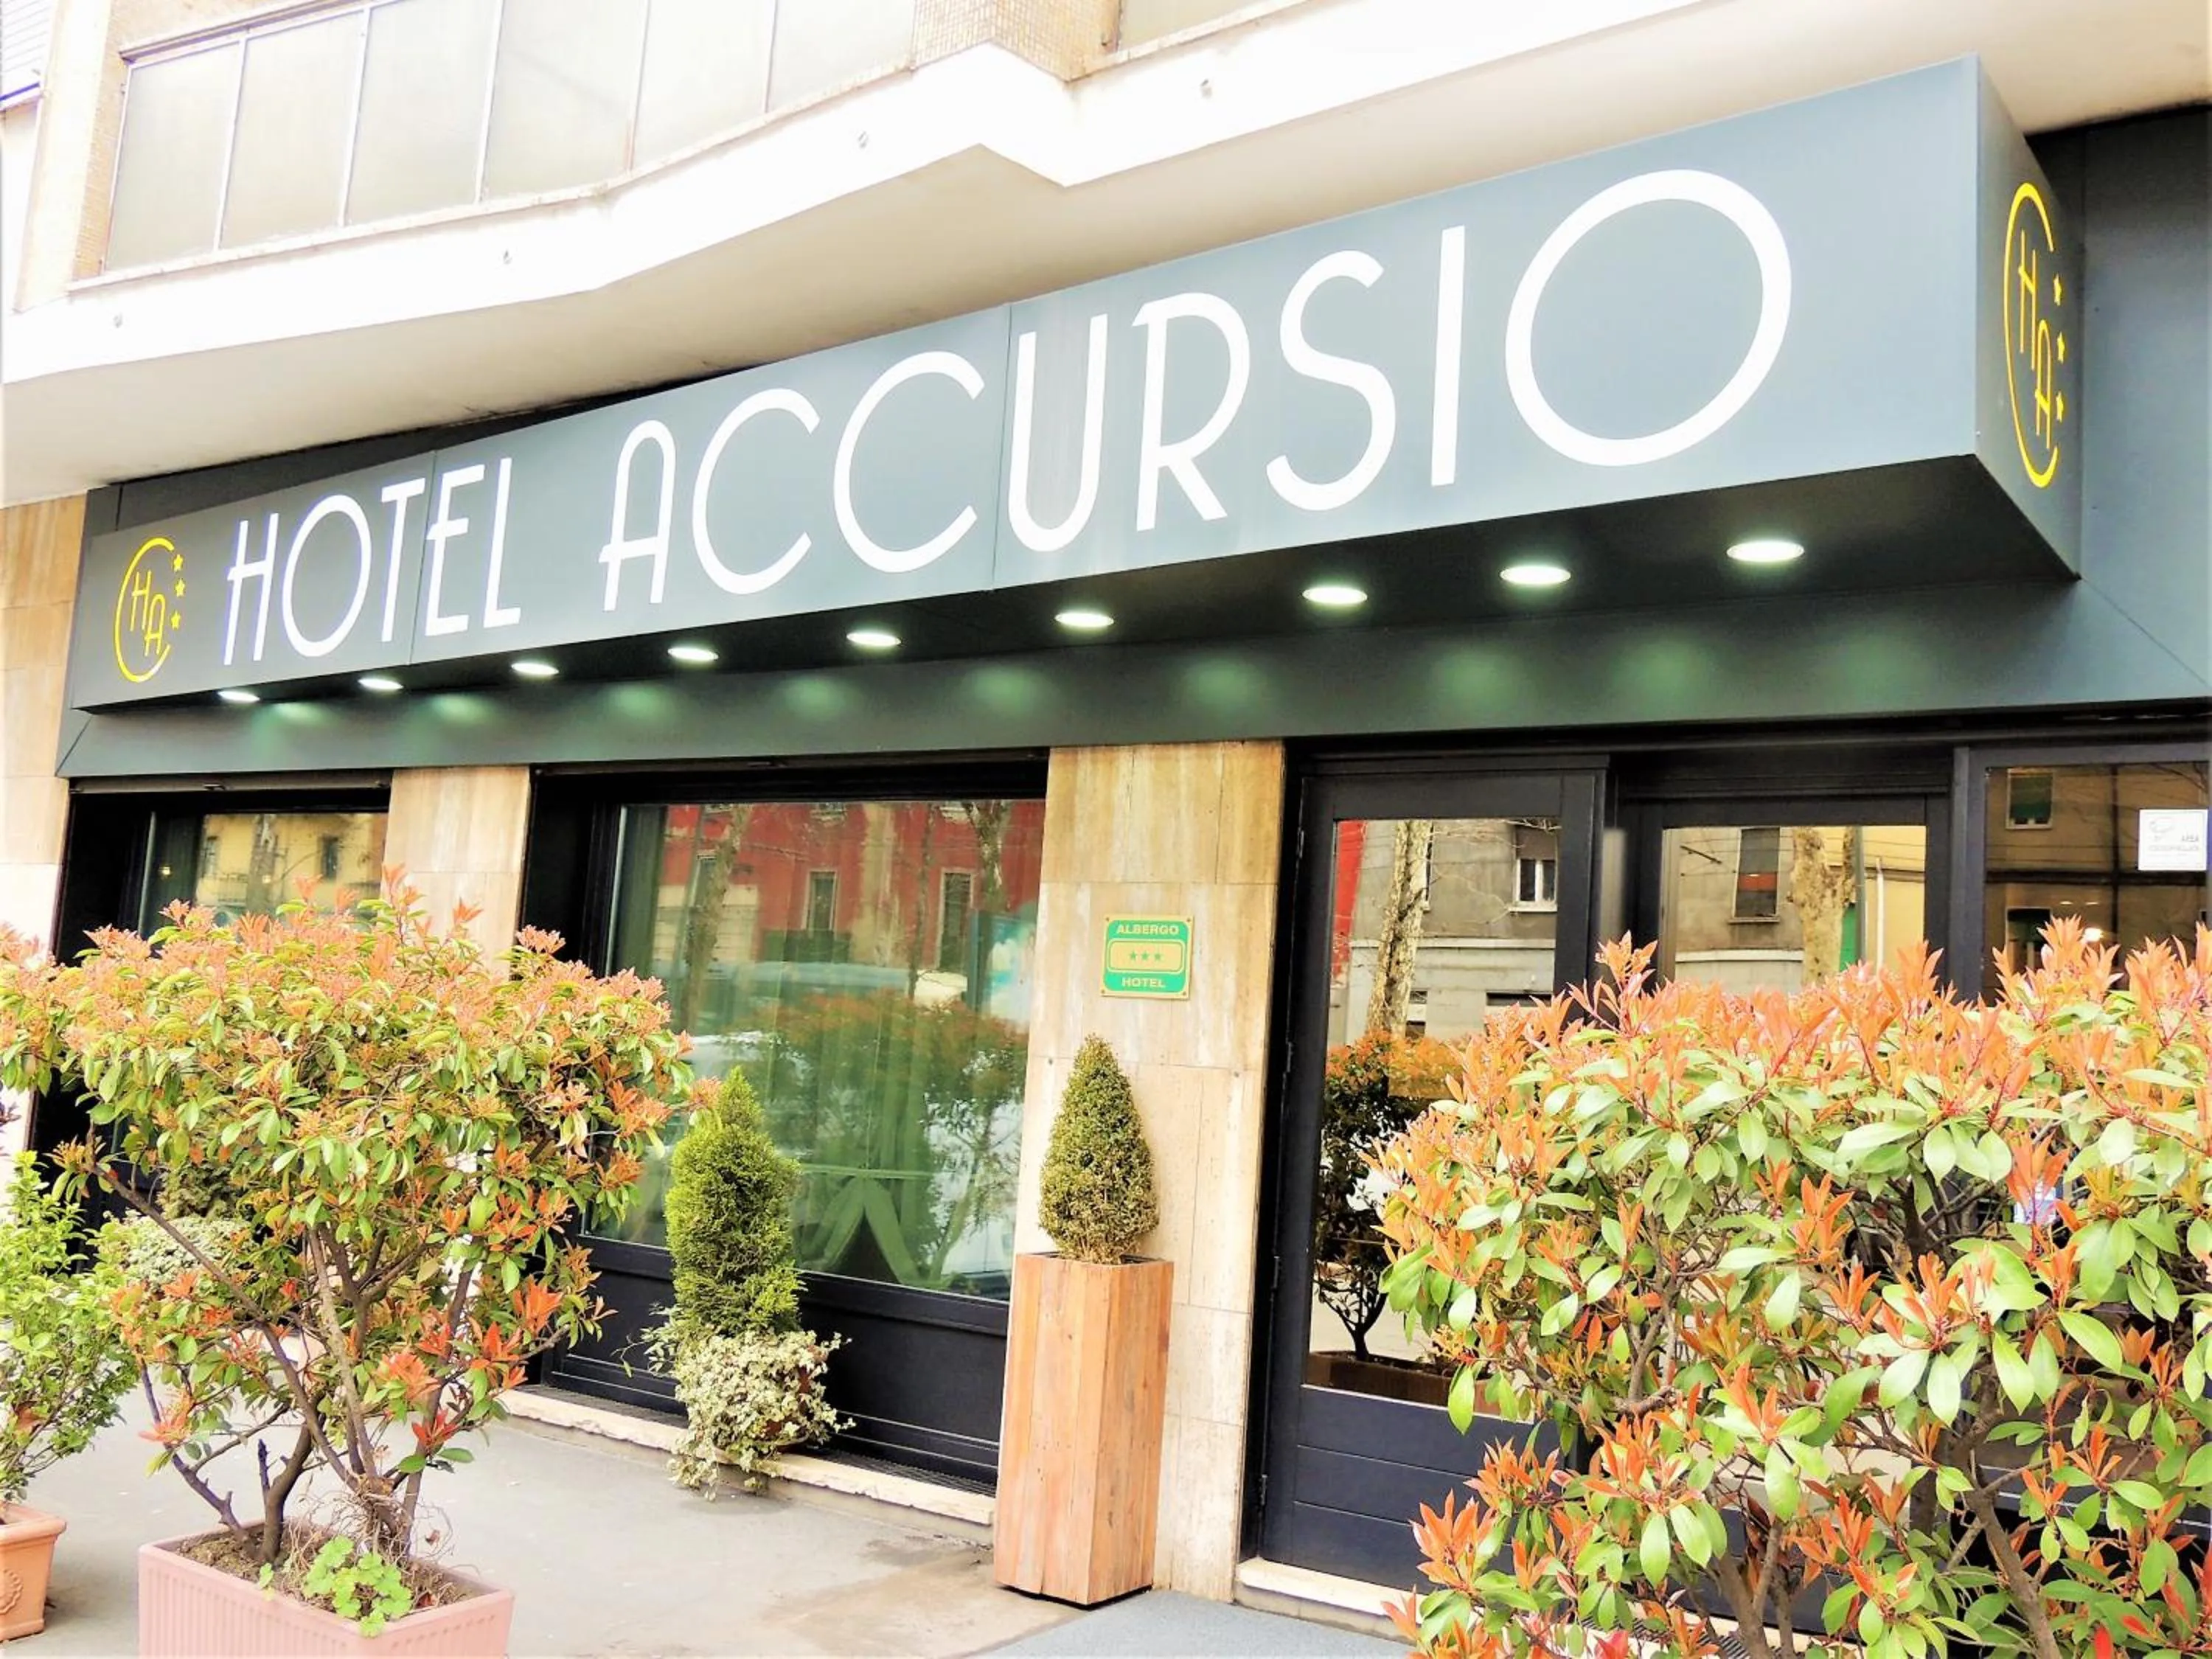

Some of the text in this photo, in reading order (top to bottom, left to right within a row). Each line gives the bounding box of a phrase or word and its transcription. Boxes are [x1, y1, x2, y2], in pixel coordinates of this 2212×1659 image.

[224, 170, 1792, 665] HOTEL ACCURSIO
[1116, 924, 1180, 935] ALBERGO
[1121, 977, 1166, 988] HOTEL
